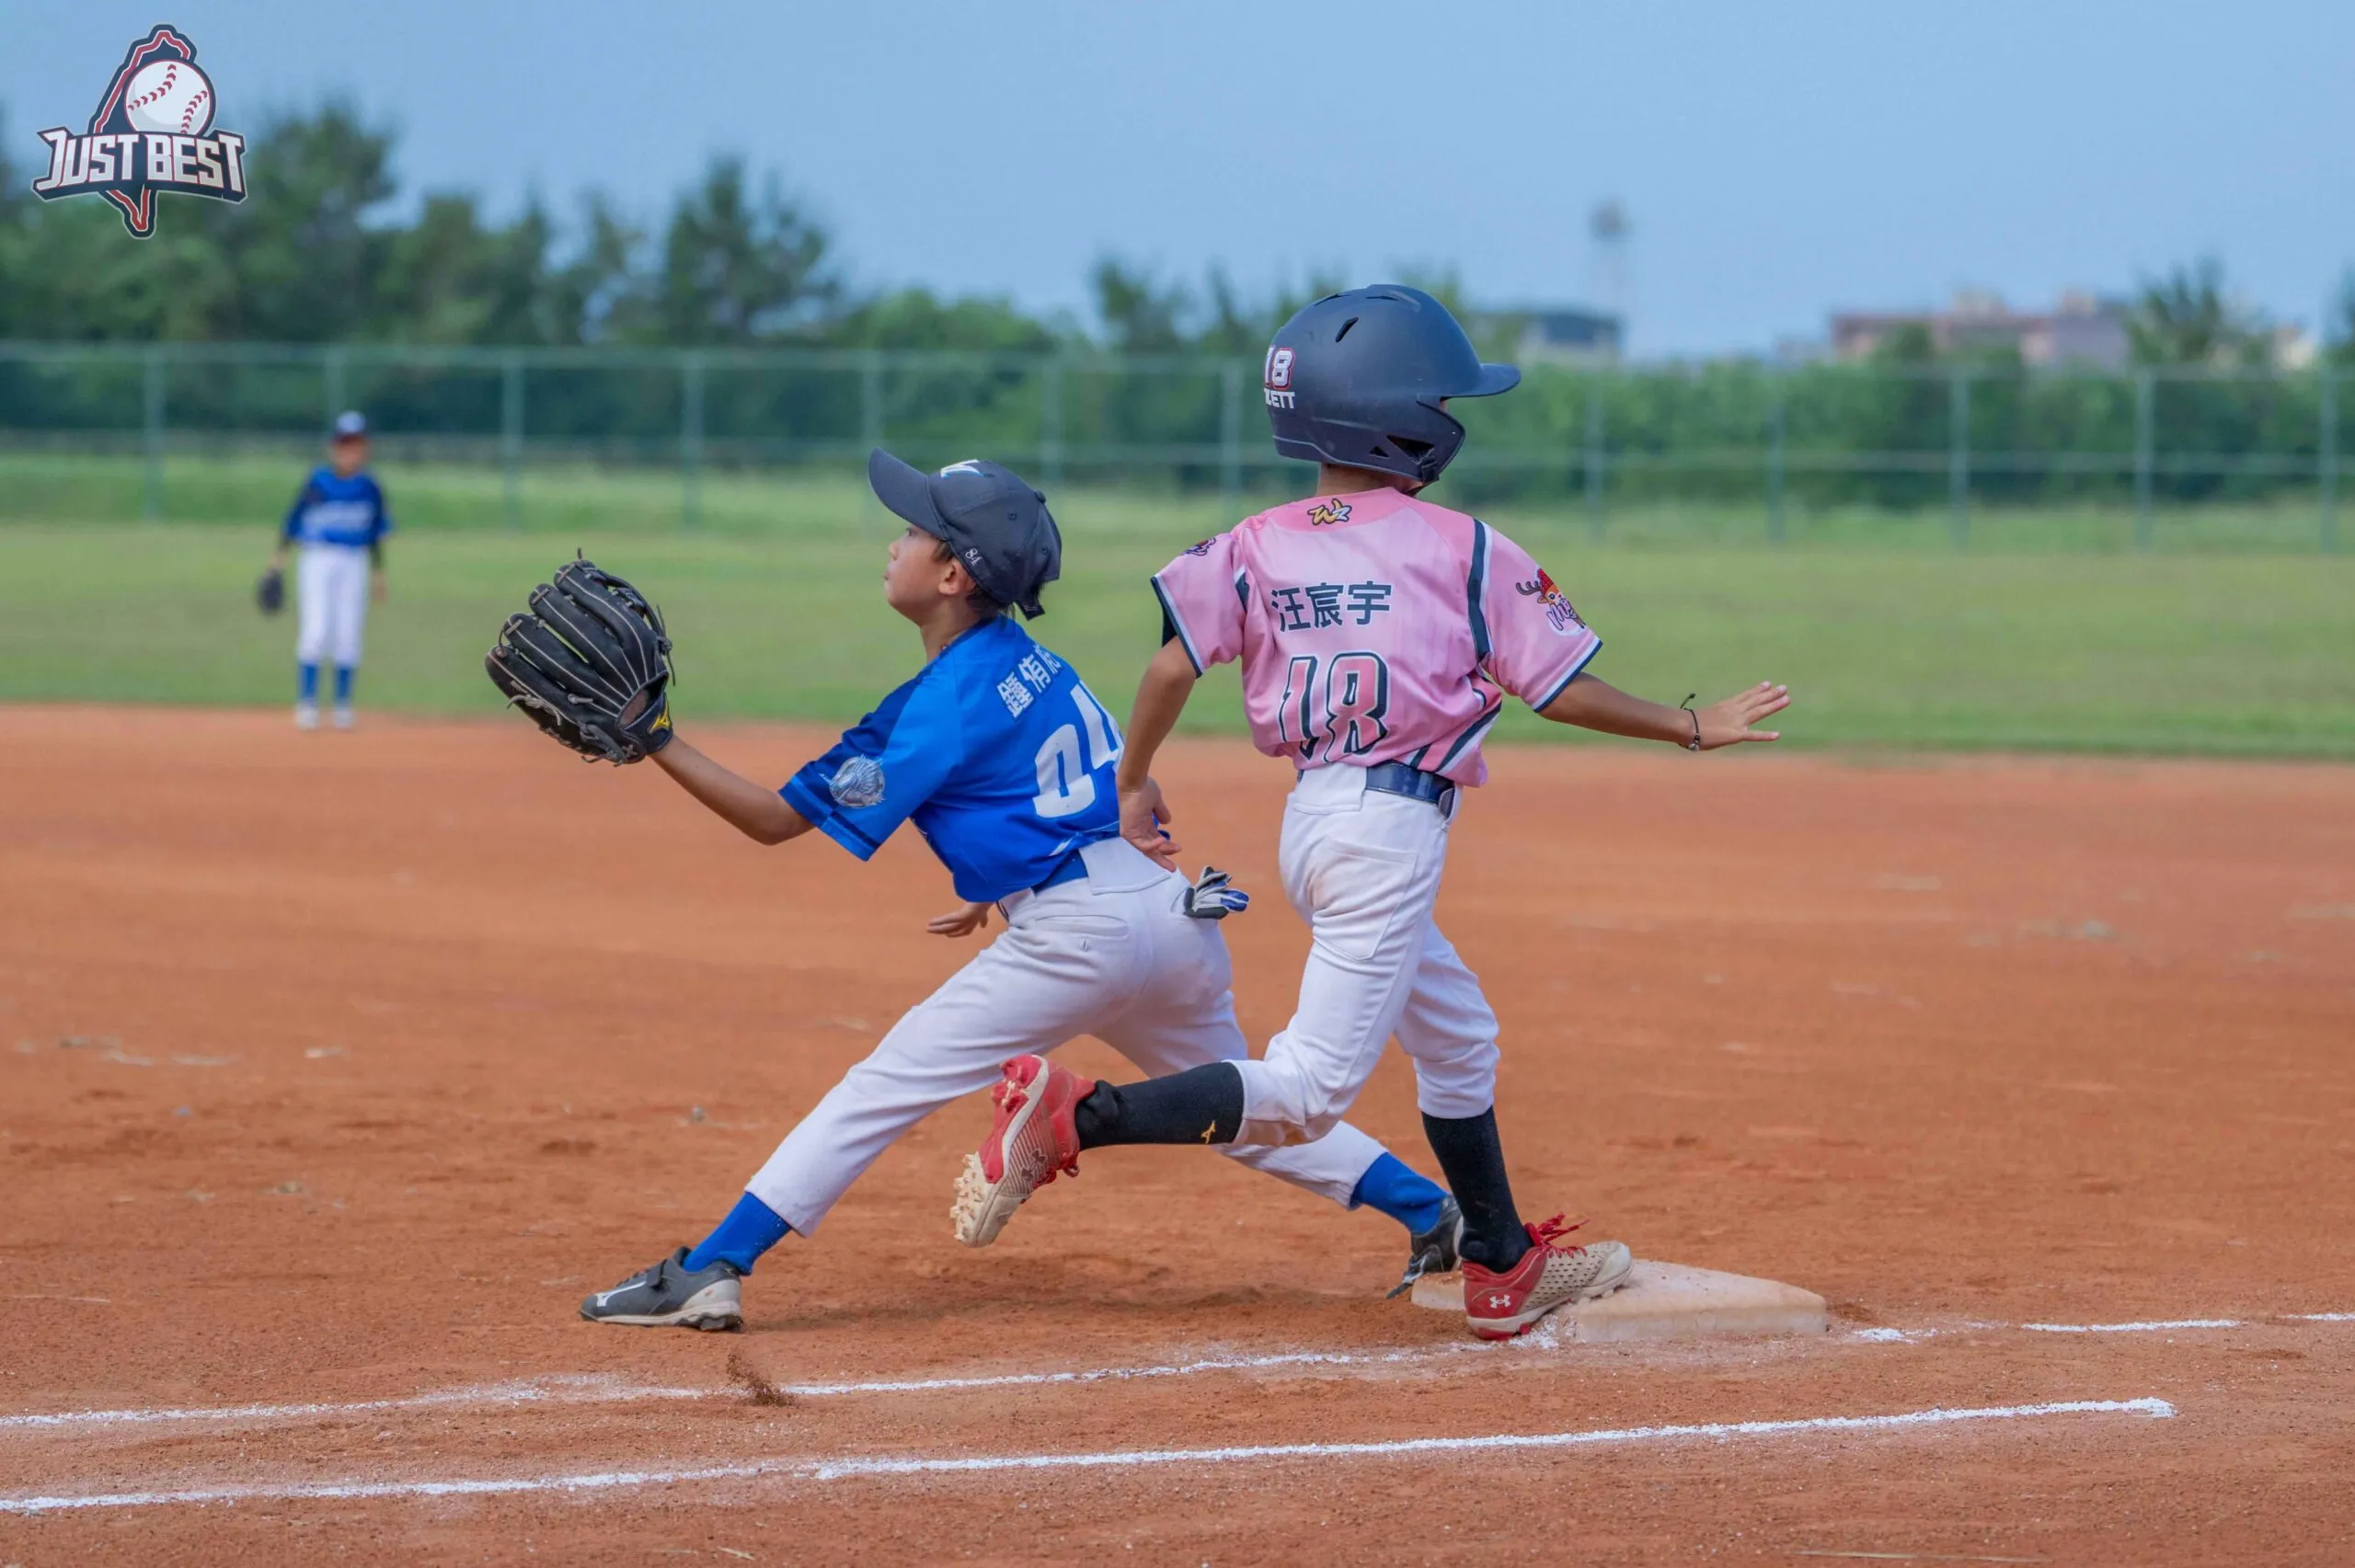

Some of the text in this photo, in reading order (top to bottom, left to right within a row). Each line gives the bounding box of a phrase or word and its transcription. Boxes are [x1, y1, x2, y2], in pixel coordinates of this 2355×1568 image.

[1264, 345, 1295, 391] 18
[966, 548, 982, 567] 84
[1270, 580, 1392, 633] 汪宸宇
[1277, 649, 1390, 763] 18
